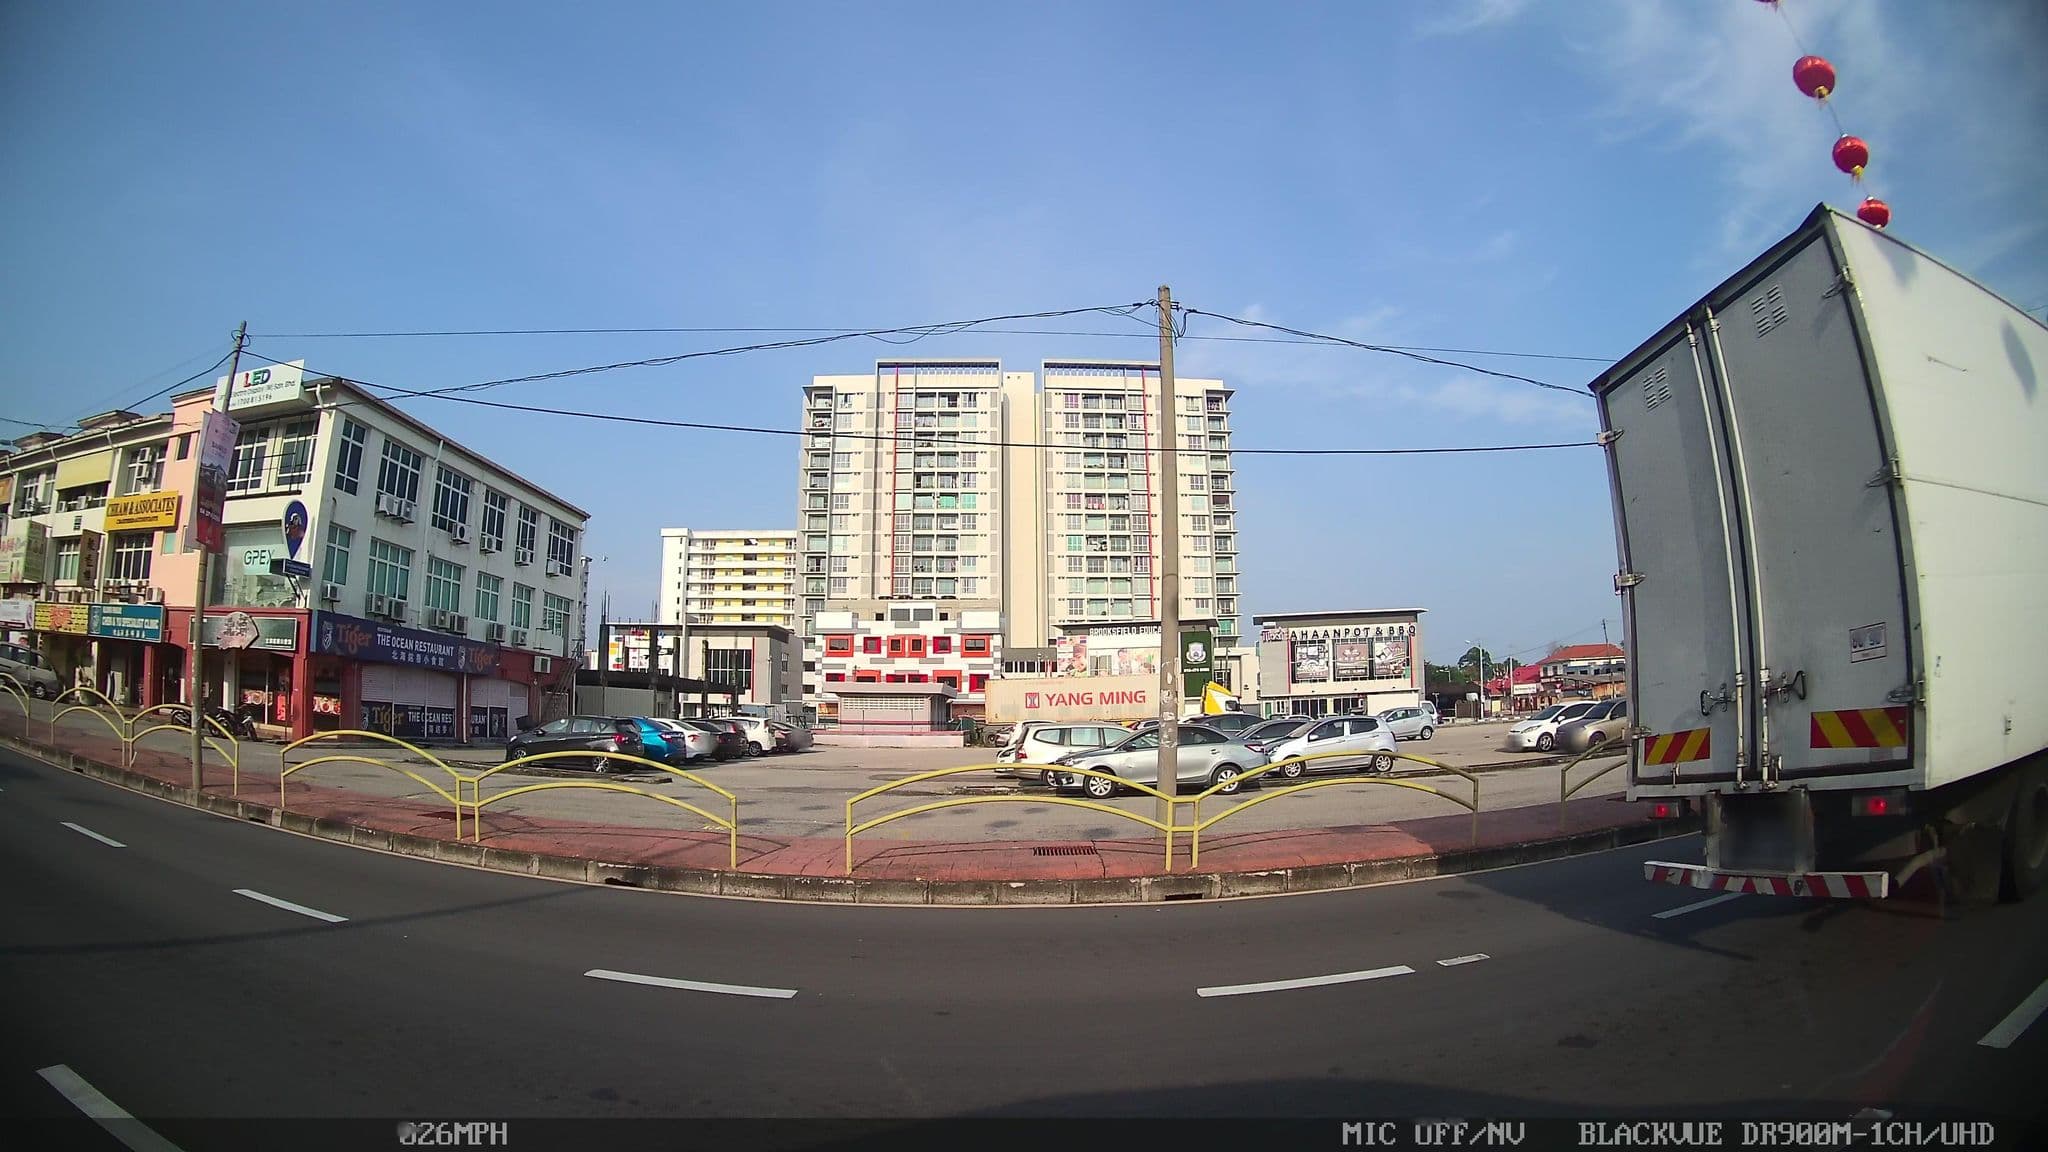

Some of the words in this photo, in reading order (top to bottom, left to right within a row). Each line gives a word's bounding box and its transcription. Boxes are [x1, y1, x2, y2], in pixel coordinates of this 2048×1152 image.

[243, 368, 271, 387] LED
[1089, 626, 1138, 637] BROOKSFIELD
[1375, 626, 1383, 635] &
[1388, 625, 1416, 637] BBQ
[377, 633, 391, 646] THE
[391, 636, 415, 650] OCEAN
[415, 640, 454, 657] RESTAURANT
[469, 647, 494, 672] Tiger
[1045, 692, 1093, 706] YANG
[1099, 690, 1146, 705] MING
[408, 711, 420, 723] THE
